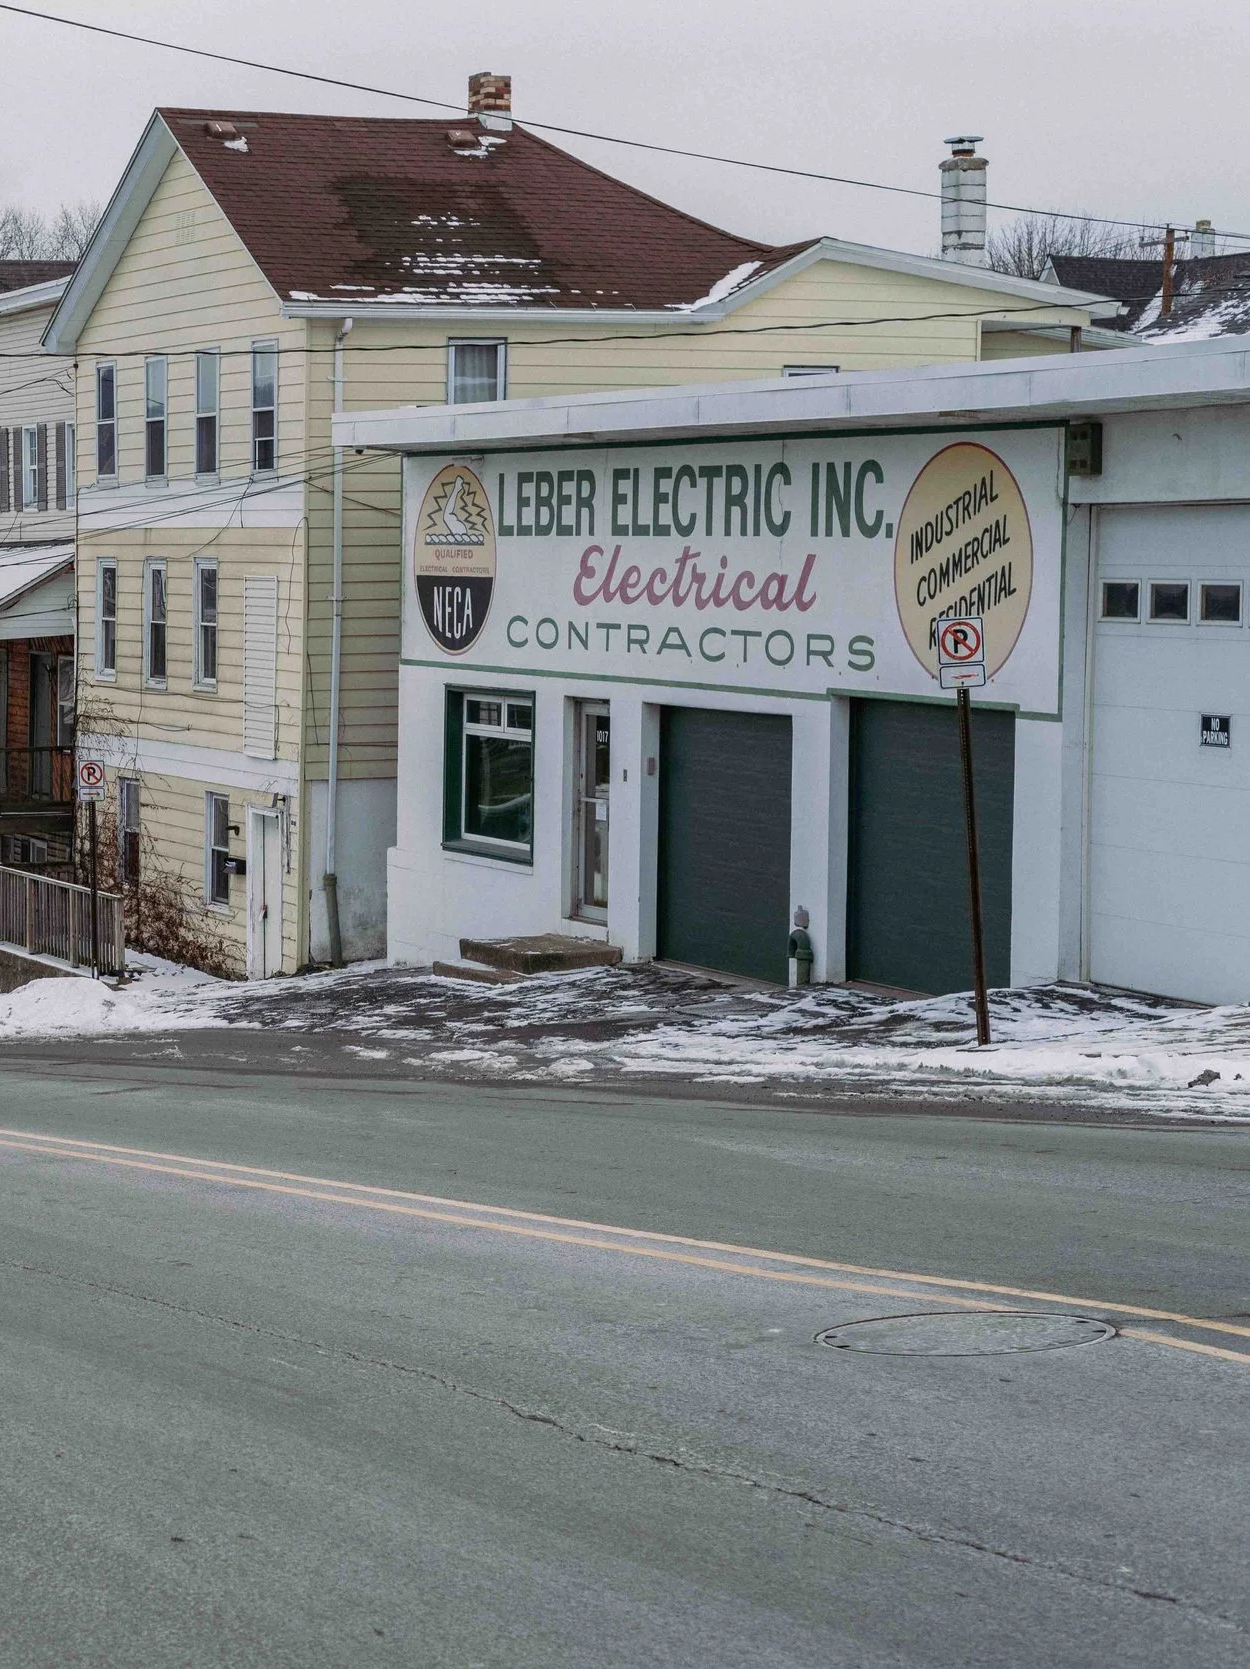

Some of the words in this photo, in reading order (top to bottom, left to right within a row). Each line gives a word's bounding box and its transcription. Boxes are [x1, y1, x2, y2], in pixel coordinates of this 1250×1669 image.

[497, 468, 597, 537] LEBER
[611, 461, 792, 538] ELECTRIC
[809, 458, 894, 540] INC.
[910, 469, 999, 565] INDUSTRIAL
[434, 548, 474, 561] QUALIFIED
[572, 543, 818, 613] Electrical
[916, 513, 1011, 608] COMMERCIAL
[433, 586, 473, 639] NECA
[928, 561, 1018, 651] RDENTIAL
[506, 614, 876, 672] CONTRACTORS
[596, 730, 609, 743] 1017
[1202, 730, 1228, 745] PARKING
[1210, 717, 1220, 731] NO
